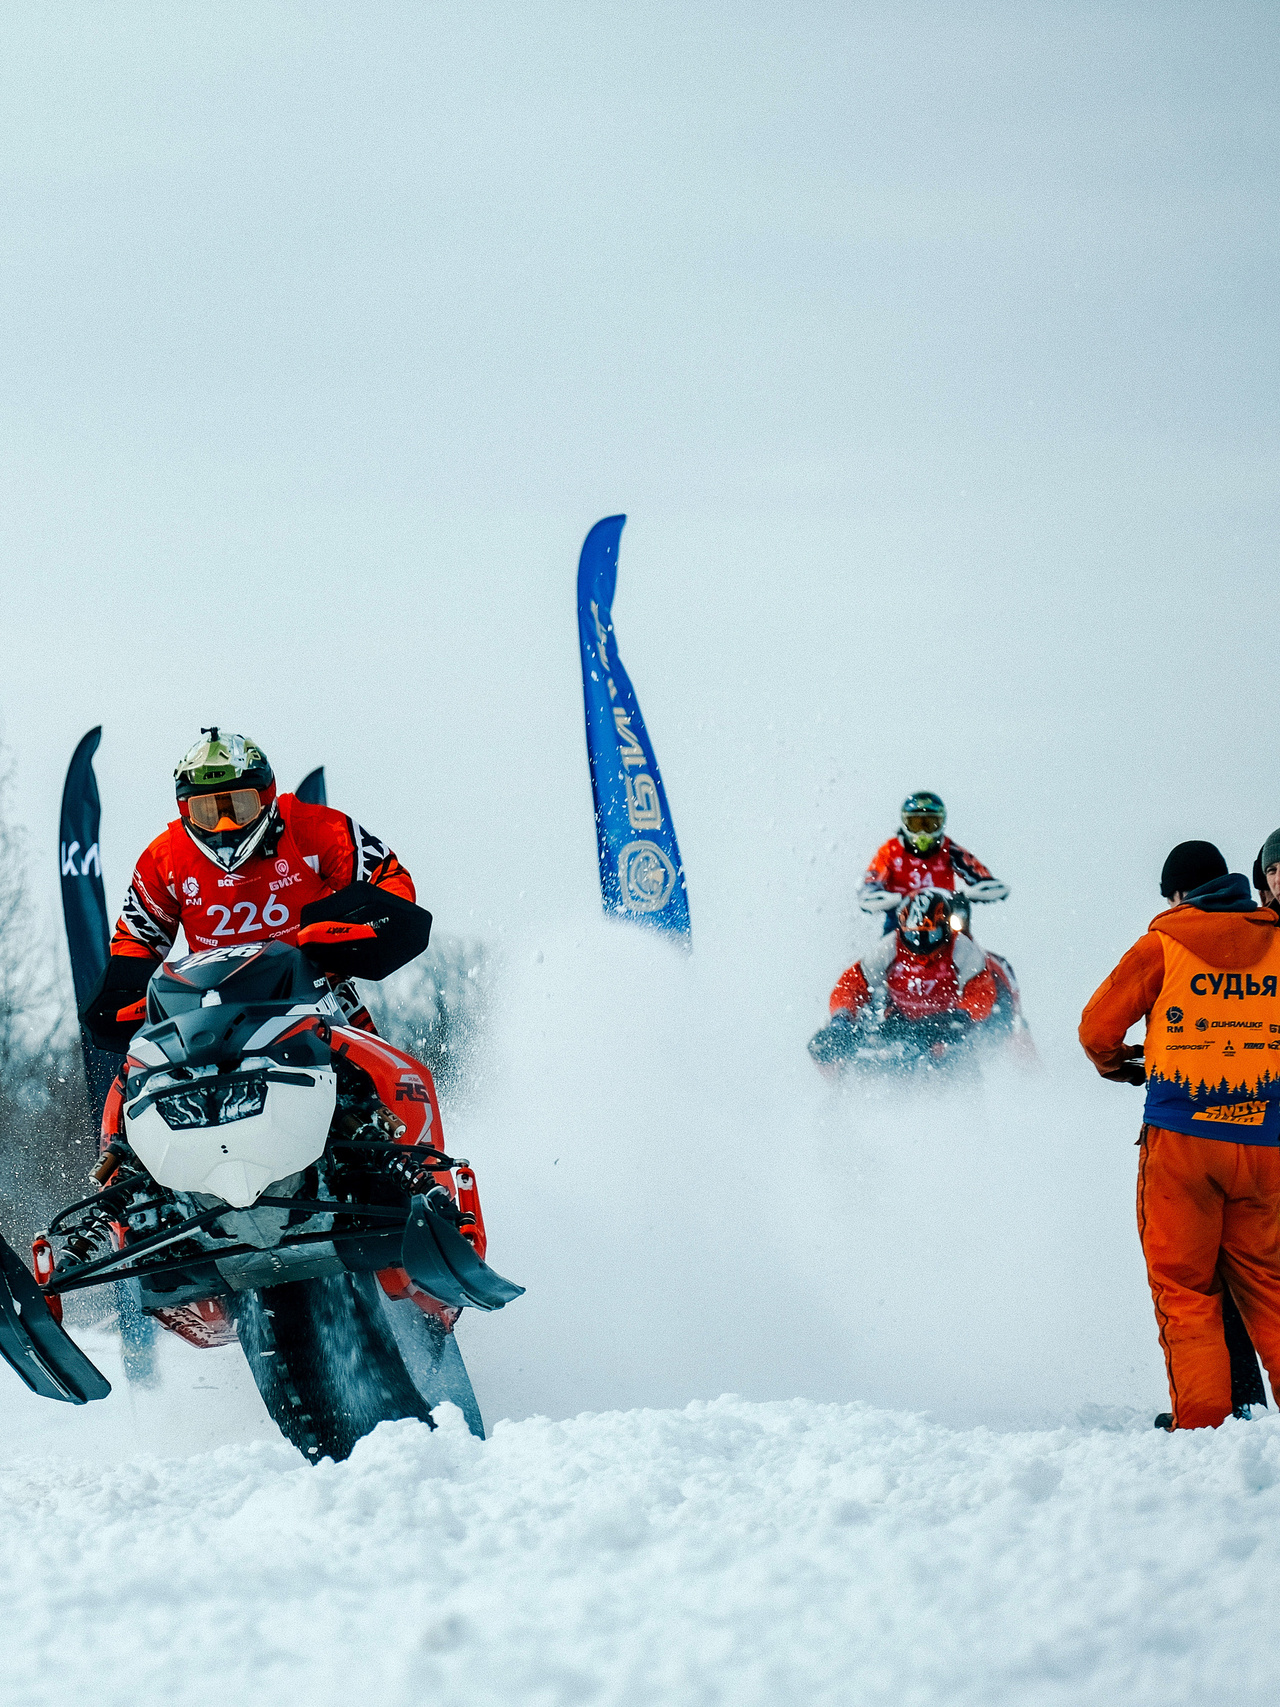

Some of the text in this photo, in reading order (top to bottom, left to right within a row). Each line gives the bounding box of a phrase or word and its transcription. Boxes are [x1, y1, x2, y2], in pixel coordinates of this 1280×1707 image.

[908, 871, 935, 889] 34
[206, 893, 290, 936] 226
[1190, 973, 1278, 1000] СУДЬЯ
[1166, 1025, 1184, 1033] RM
[1243, 1042, 1266, 1050] YOKO
[395, 1083, 431, 1104] RS
[1204, 1100, 1269, 1117] SNOW
